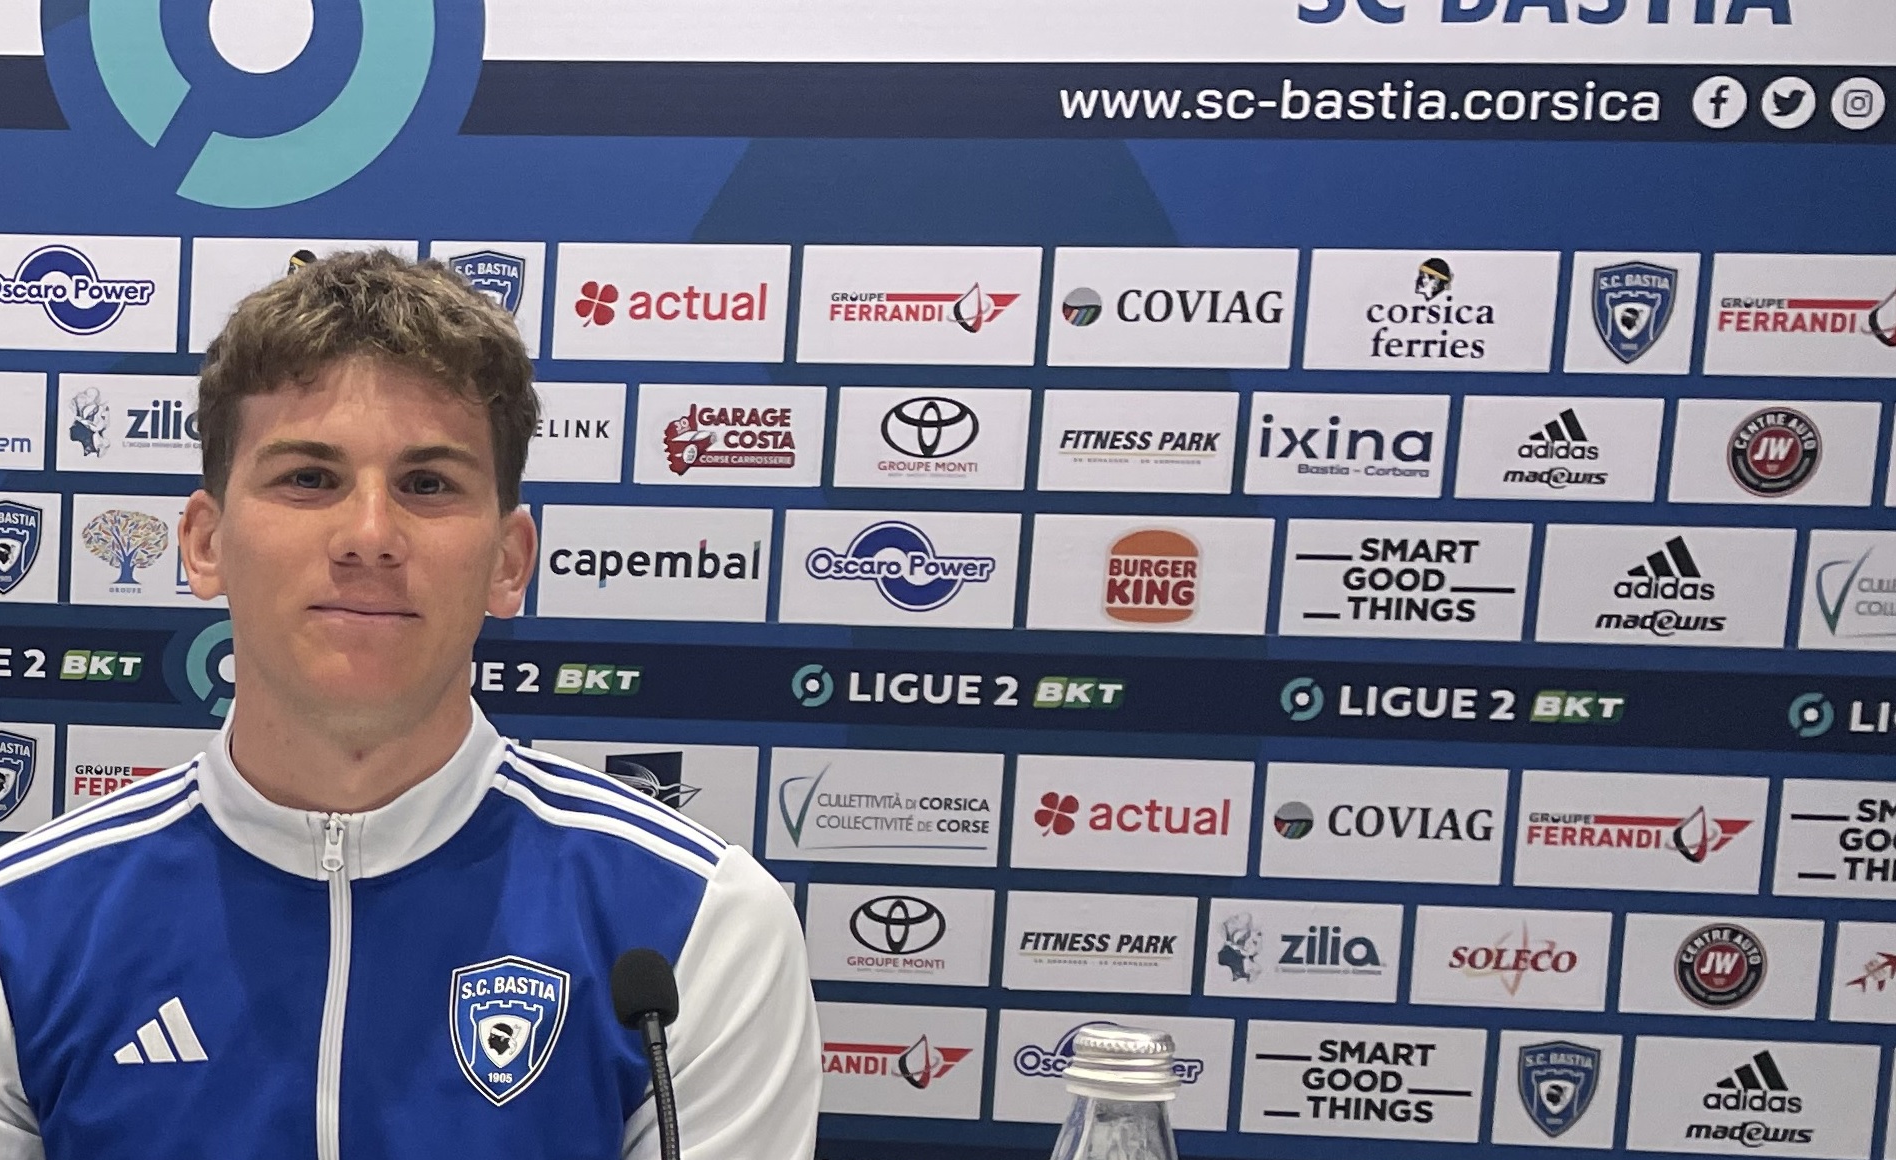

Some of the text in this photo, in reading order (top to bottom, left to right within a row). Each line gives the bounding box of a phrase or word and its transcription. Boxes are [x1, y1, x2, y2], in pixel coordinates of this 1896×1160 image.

[1060, 78, 1661, 122] www.sc-bastia.corsica
[74, 279, 150, 302] Power
[1721, 298, 1785, 309] GROUPE
[1117, 289, 1284, 325] COVIAG
[1366, 296, 1495, 326] corsica
[1718, 311, 1856, 334] FERRANDI
[1371, 326, 1485, 360] ferries
[697, 407, 791, 428] GARAGE
[724, 429, 795, 450] COSTA
[1059, 429, 1220, 452] FITNESS PARK
[1260, 414, 1433, 463] ixina
[878, 460, 978, 472] GROUPE MONTI
[1359, 538, 1480, 565] SMART
[1109, 558, 1197, 579] BURGER
[1343, 567, 1445, 593] GOOD
[1105, 579, 1195, 606] KING
[1614, 577, 1715, 602] adidas
[1347, 596, 1477, 623] THINGS
[24, 649, 46, 678] 2
[63, 654, 141, 677] BKT
[1339, 685, 1624, 720] LIGUE 2 BKT
[817, 791, 902, 811] CULLETTIVITÀ
[918, 796, 990, 813] CORSICA
[816, 812, 990, 835] COLLECTIVITÉ DE CORSE
[1089, 798, 1231, 836] actual
[1328, 803, 1494, 842] COVIAG
[1280, 925, 1380, 967] zilia
[1449, 945, 1577, 974] SOLECO
[461, 976, 556, 1003] S.C. BASTIA
[487, 1072, 513, 1084] 1905
[1702, 1089, 1802, 1113] adidas
